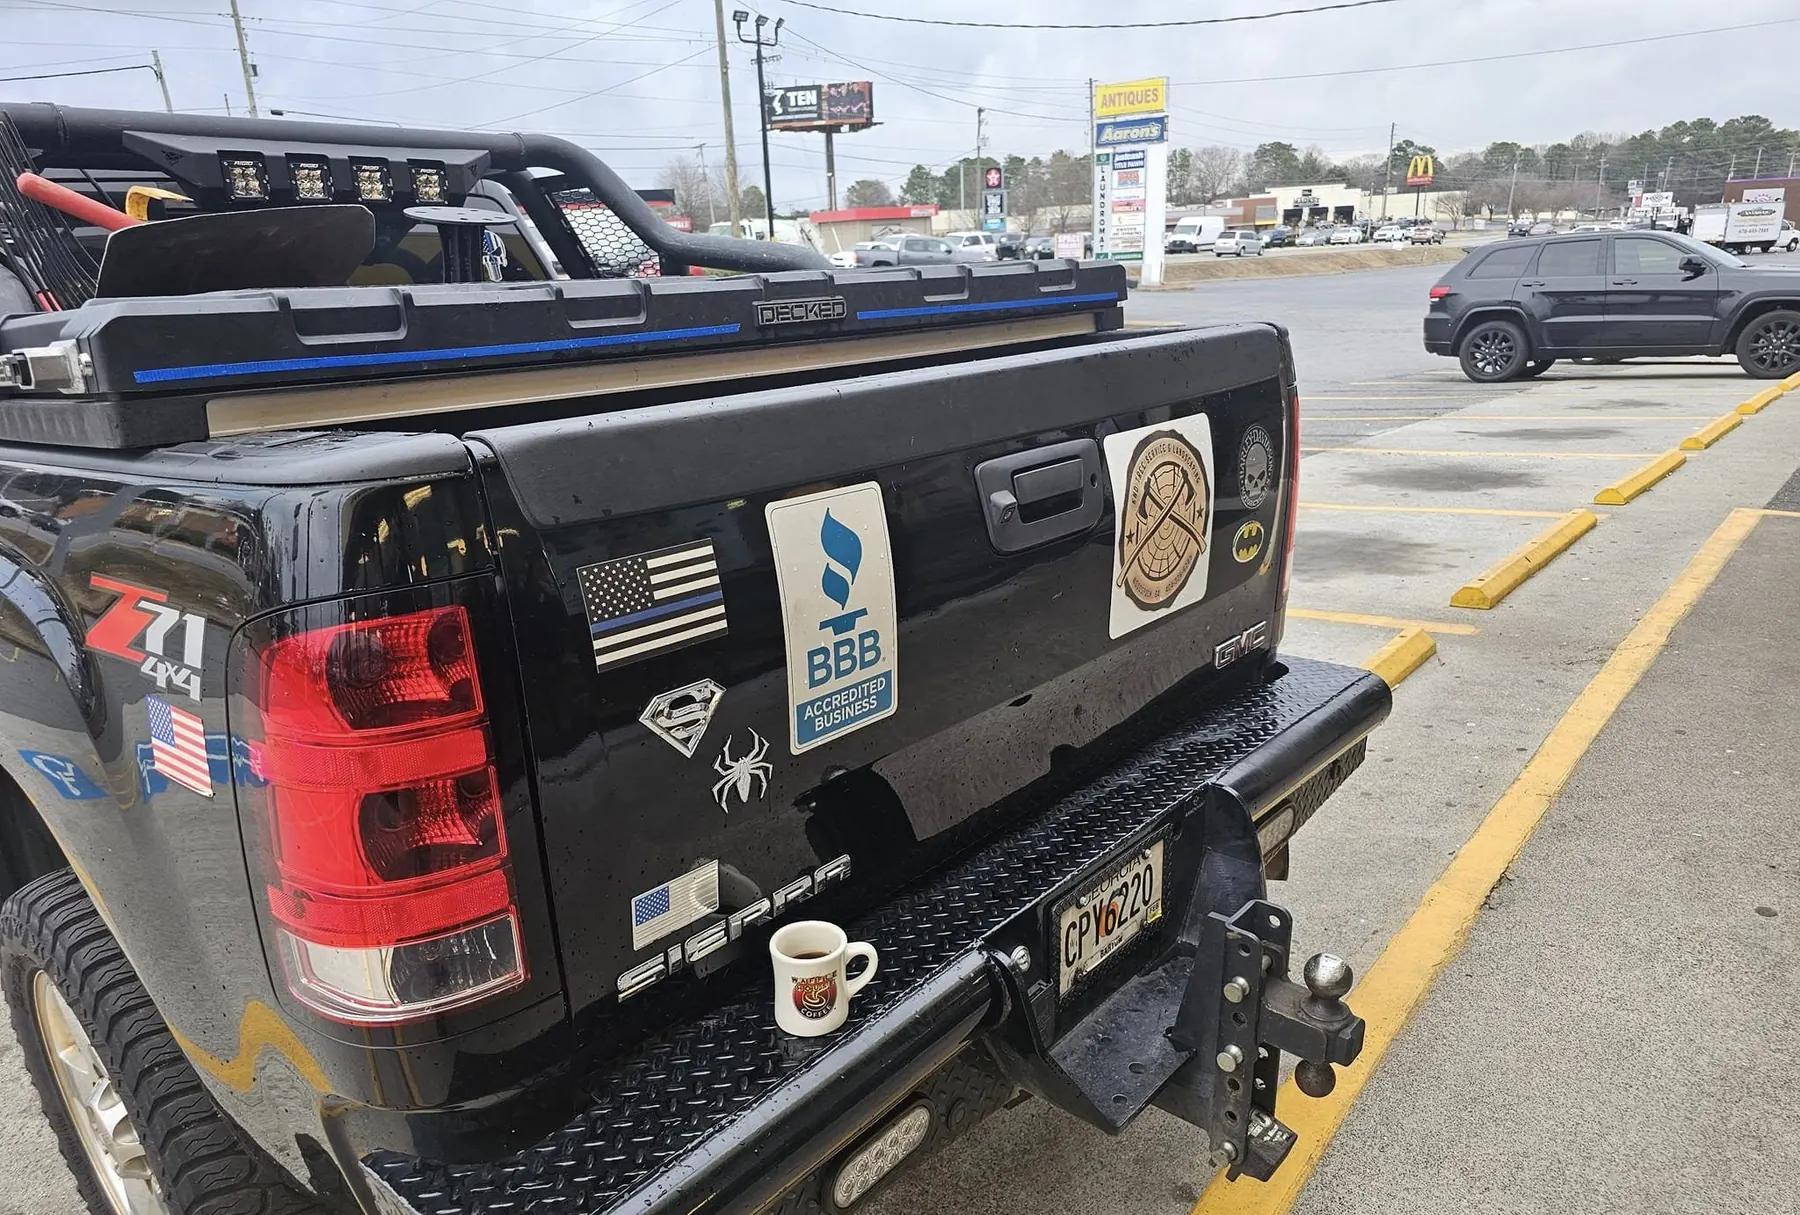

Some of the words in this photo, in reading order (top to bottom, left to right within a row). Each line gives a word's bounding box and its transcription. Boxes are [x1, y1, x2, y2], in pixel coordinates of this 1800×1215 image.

[786, 90, 817, 107] TEN
[1101, 88, 1159, 108] ANTIQUES
[1099, 123, 1161, 143] Aaron's
[759, 301, 846, 324] DECKED
[1145, 443, 1166, 464] SERVICE
[1172, 445, 1201, 484] LANDSCAPING
[84, 575, 206, 669] Z71
[807, 629, 881, 690] BBB
[1215, 620, 1267, 670] GMC
[804, 677, 886, 720] ACCREDITED
[815, 696, 877, 732] BUSINESS
[617, 854, 851, 1003] SIERRA
[1064, 864, 1153, 968] CPY6220
[791, 970, 838, 984] WAFFLE
[801, 1005, 832, 1018] COFFEE
